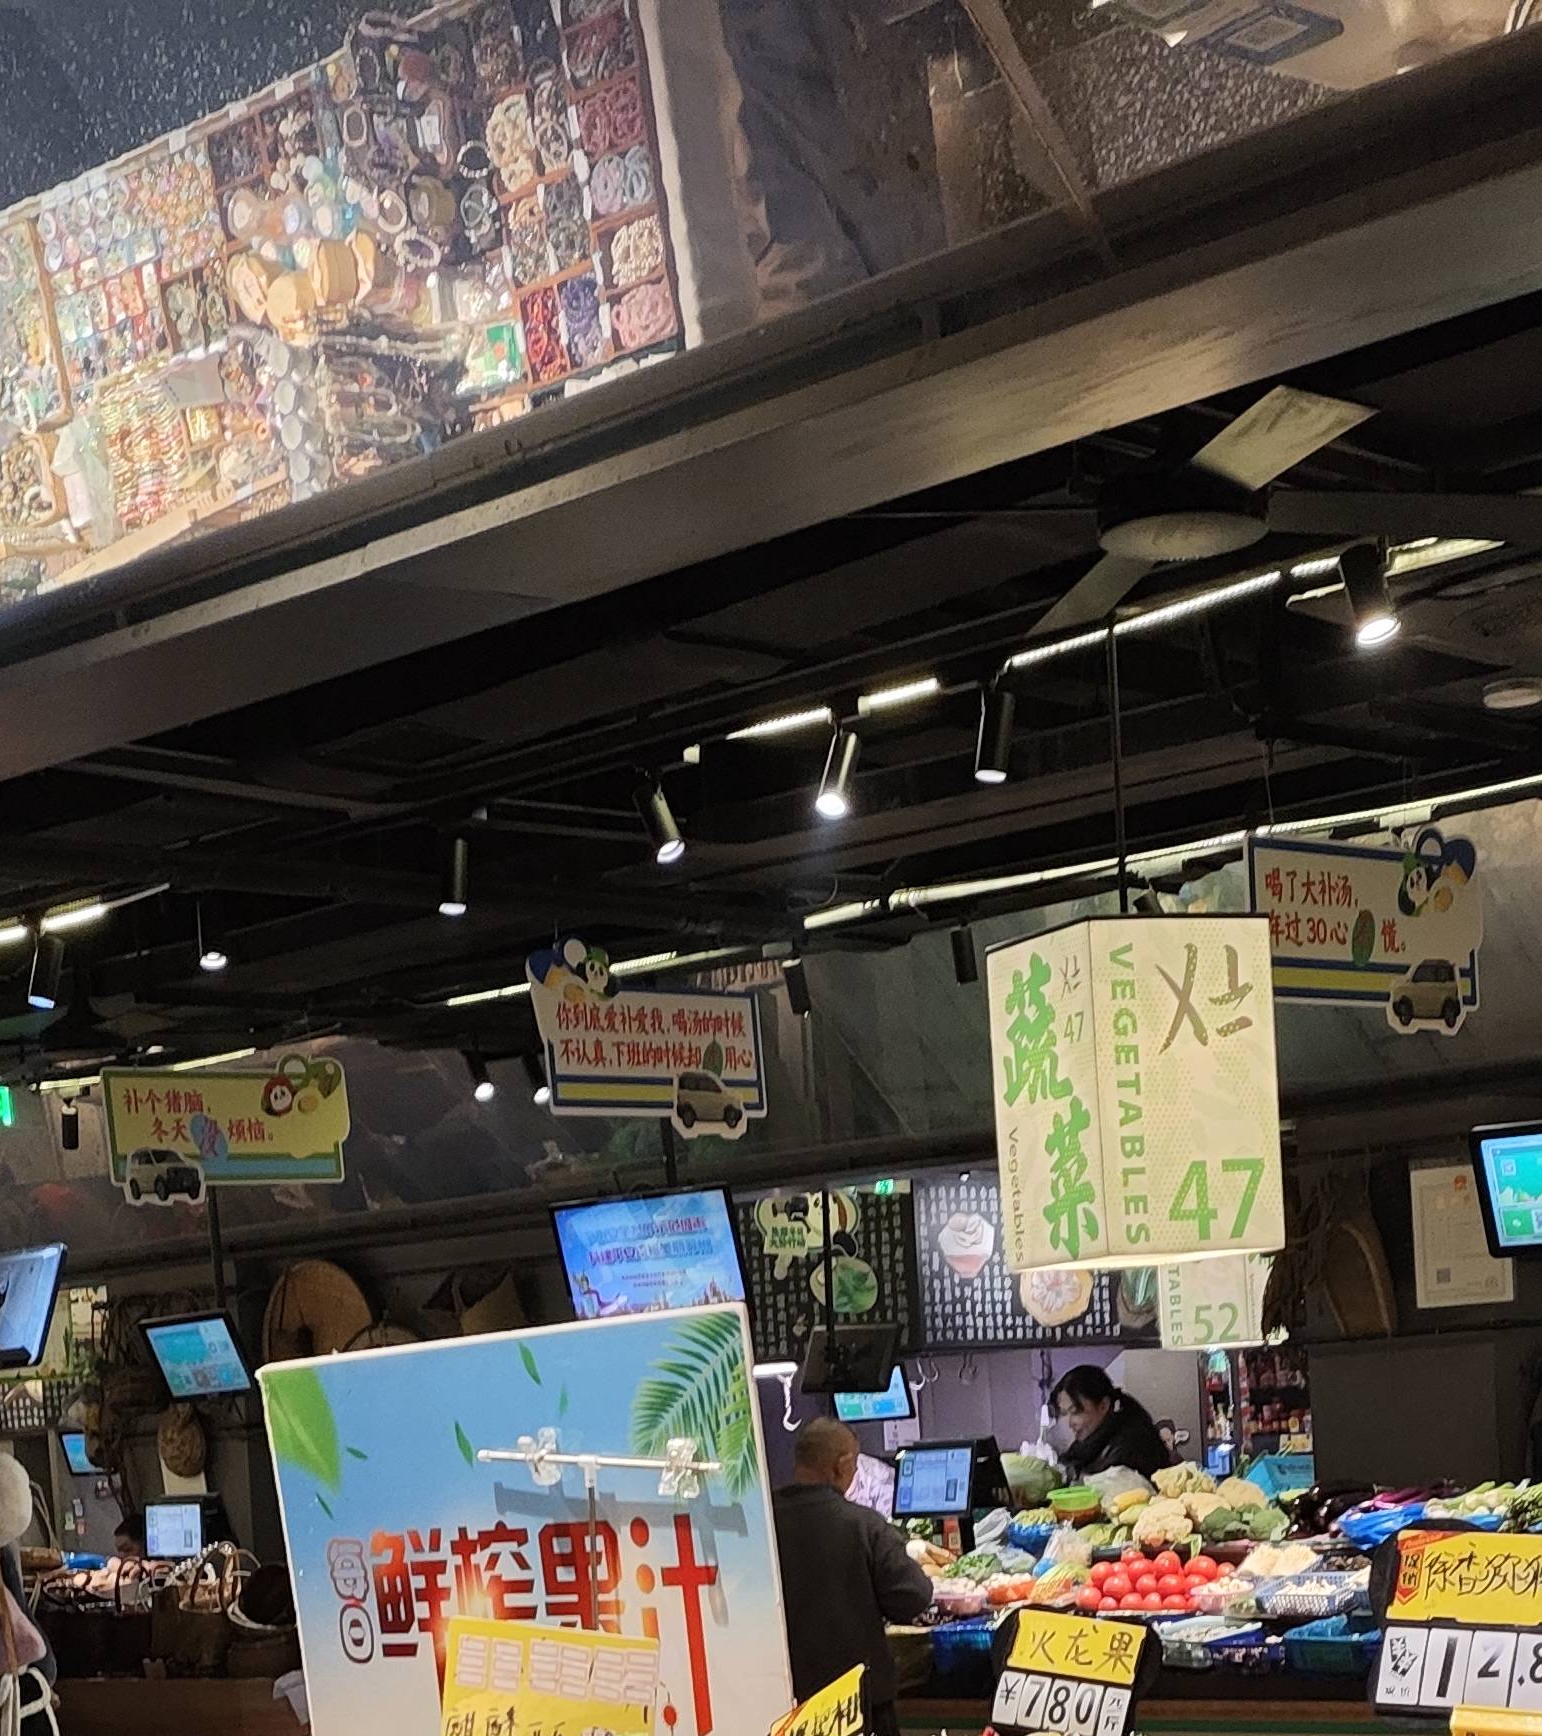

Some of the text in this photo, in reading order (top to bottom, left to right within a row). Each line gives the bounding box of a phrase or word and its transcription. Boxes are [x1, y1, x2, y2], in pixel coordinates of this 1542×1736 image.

[1109, 942, 1150, 1246] VEGETABLES
[1008, 1125, 1027, 1263] Vegetables
[1168, 1157, 1266, 1241] 47
[1193, 1301, 1241, 1344] 52
[1010, 1624, 1135, 1674] 火龙果
